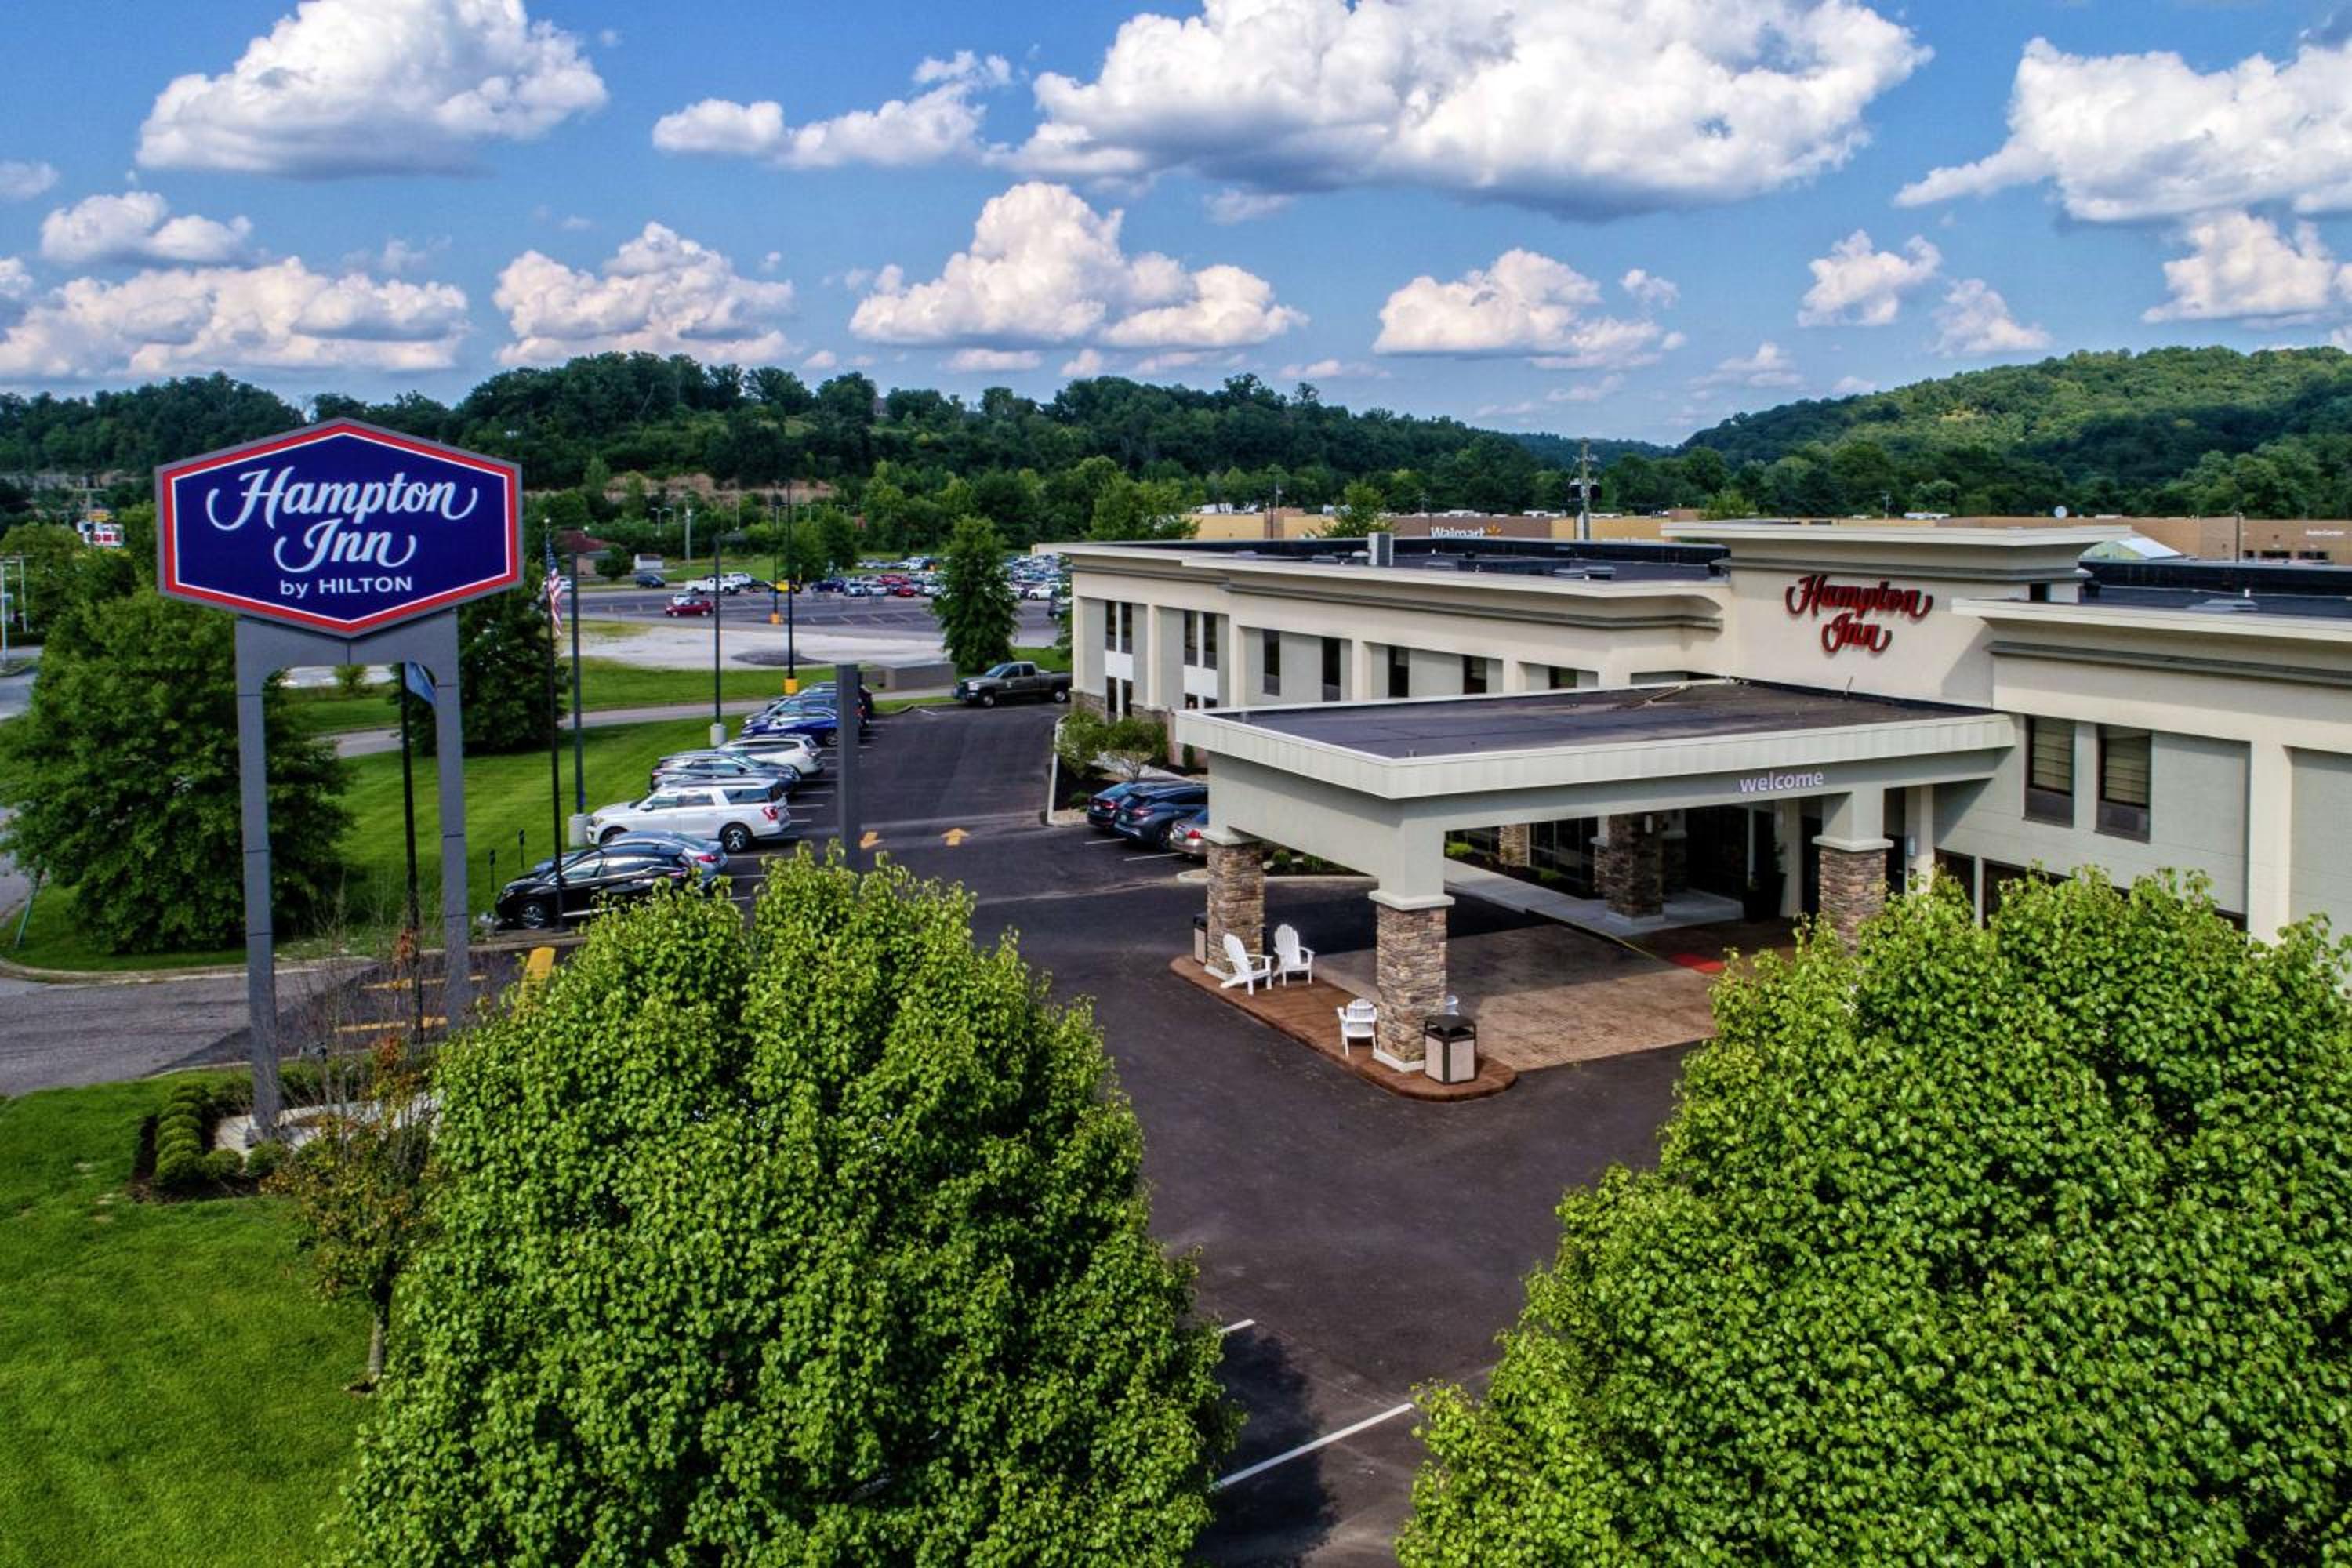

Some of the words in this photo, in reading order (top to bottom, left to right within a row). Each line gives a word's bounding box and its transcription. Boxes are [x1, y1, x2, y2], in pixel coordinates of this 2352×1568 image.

[205, 465, 478, 531] Hampton
[274, 517, 416, 572] Inn
[1429, 526, 1485, 539] Walmart
[279, 579, 309, 599] by
[318, 576, 413, 594] HILTON
[1785, 575, 1934, 619] Hampton
[1821, 612, 1893, 652] Inn
[1740, 771, 1824, 793] welcome
